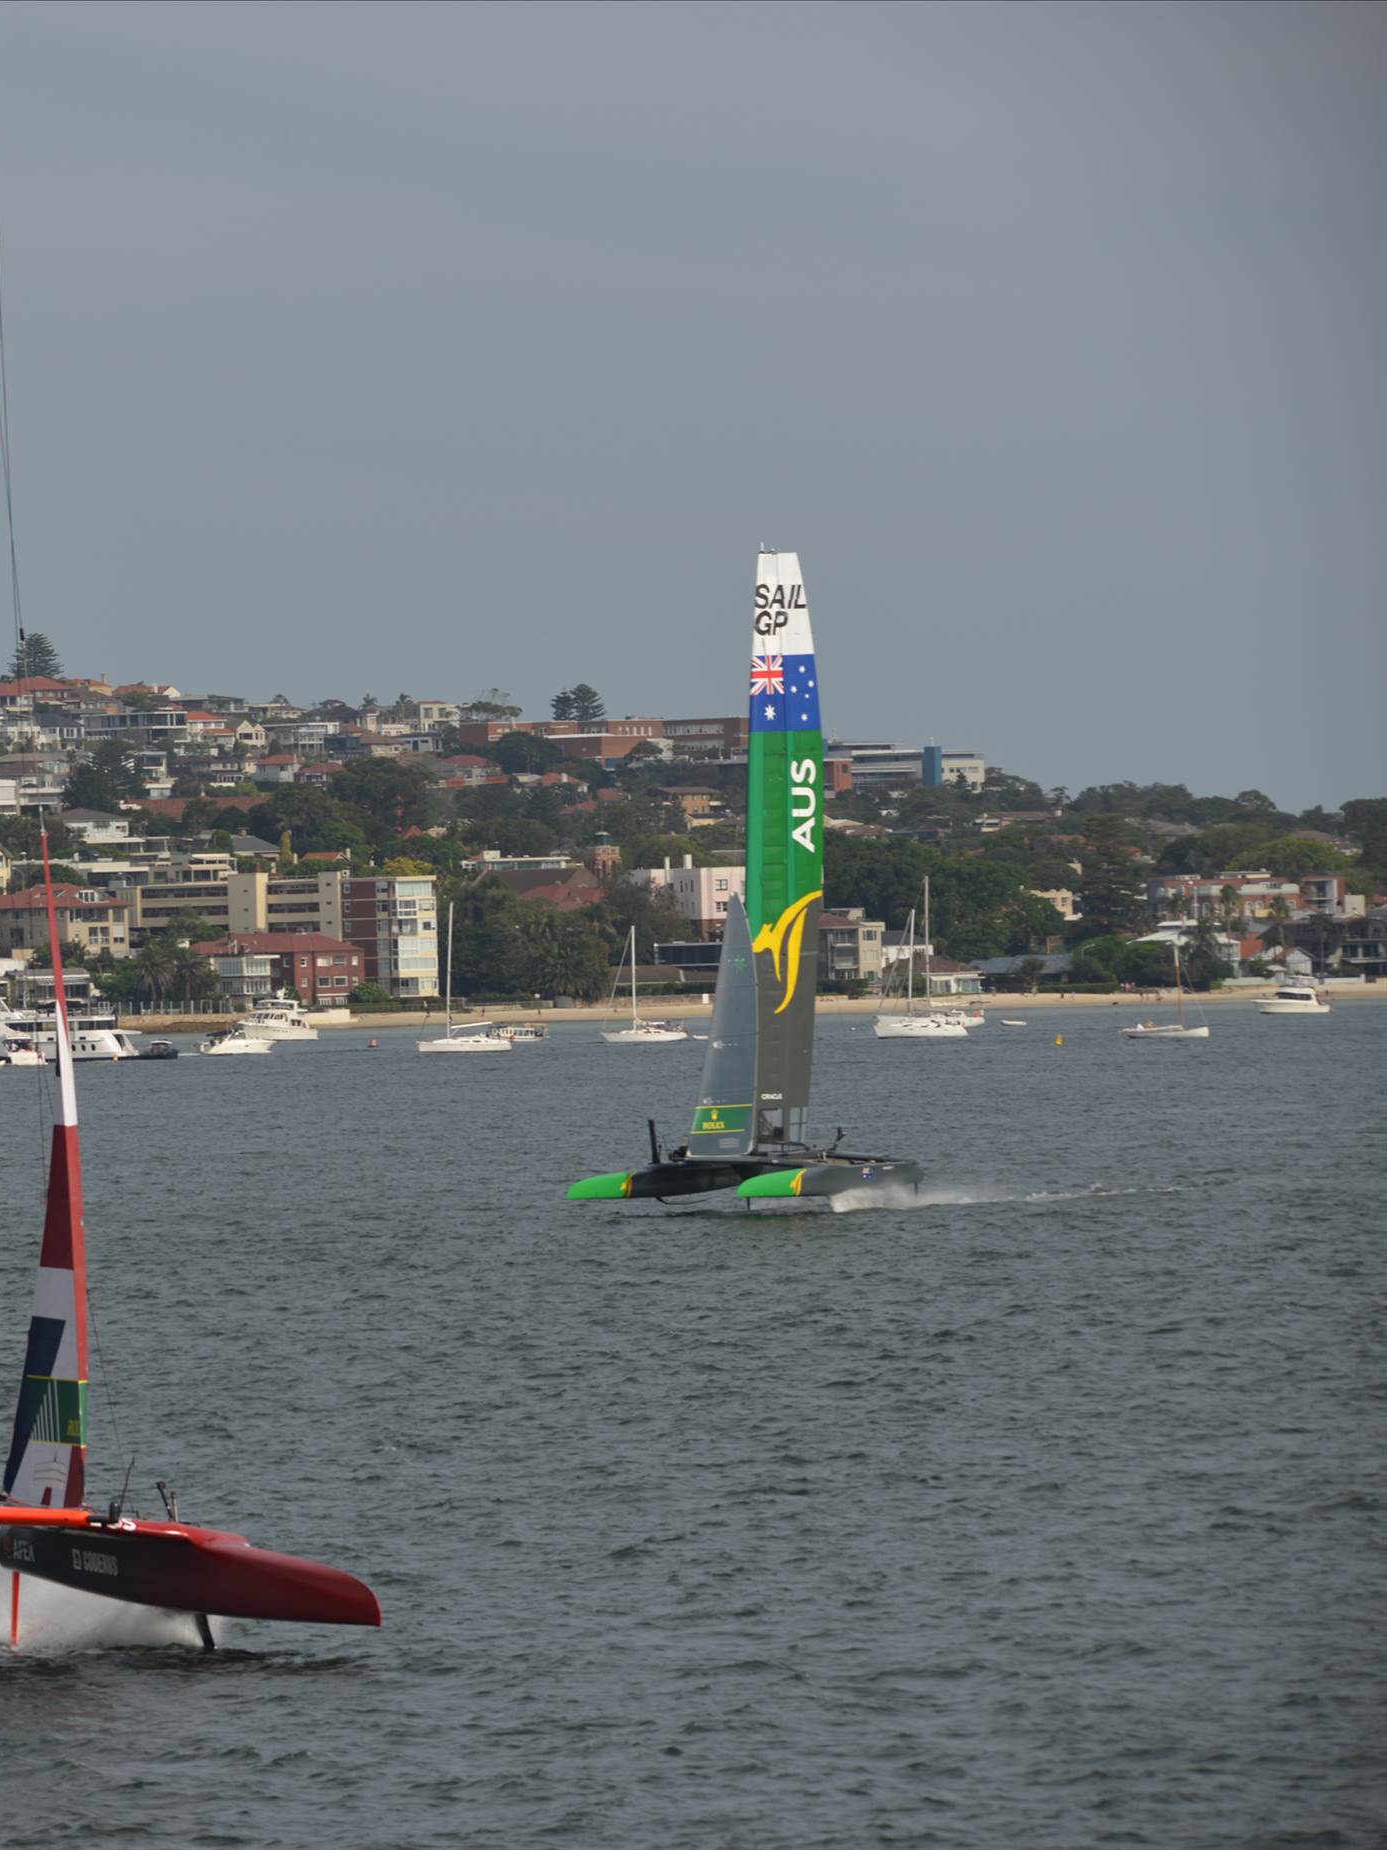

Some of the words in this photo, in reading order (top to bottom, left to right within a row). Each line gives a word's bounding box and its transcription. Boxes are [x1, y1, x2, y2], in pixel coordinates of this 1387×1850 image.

[755, 584, 807, 609] SAIL
[754, 610, 788, 636] GP
[791, 759, 817, 853] AUS
